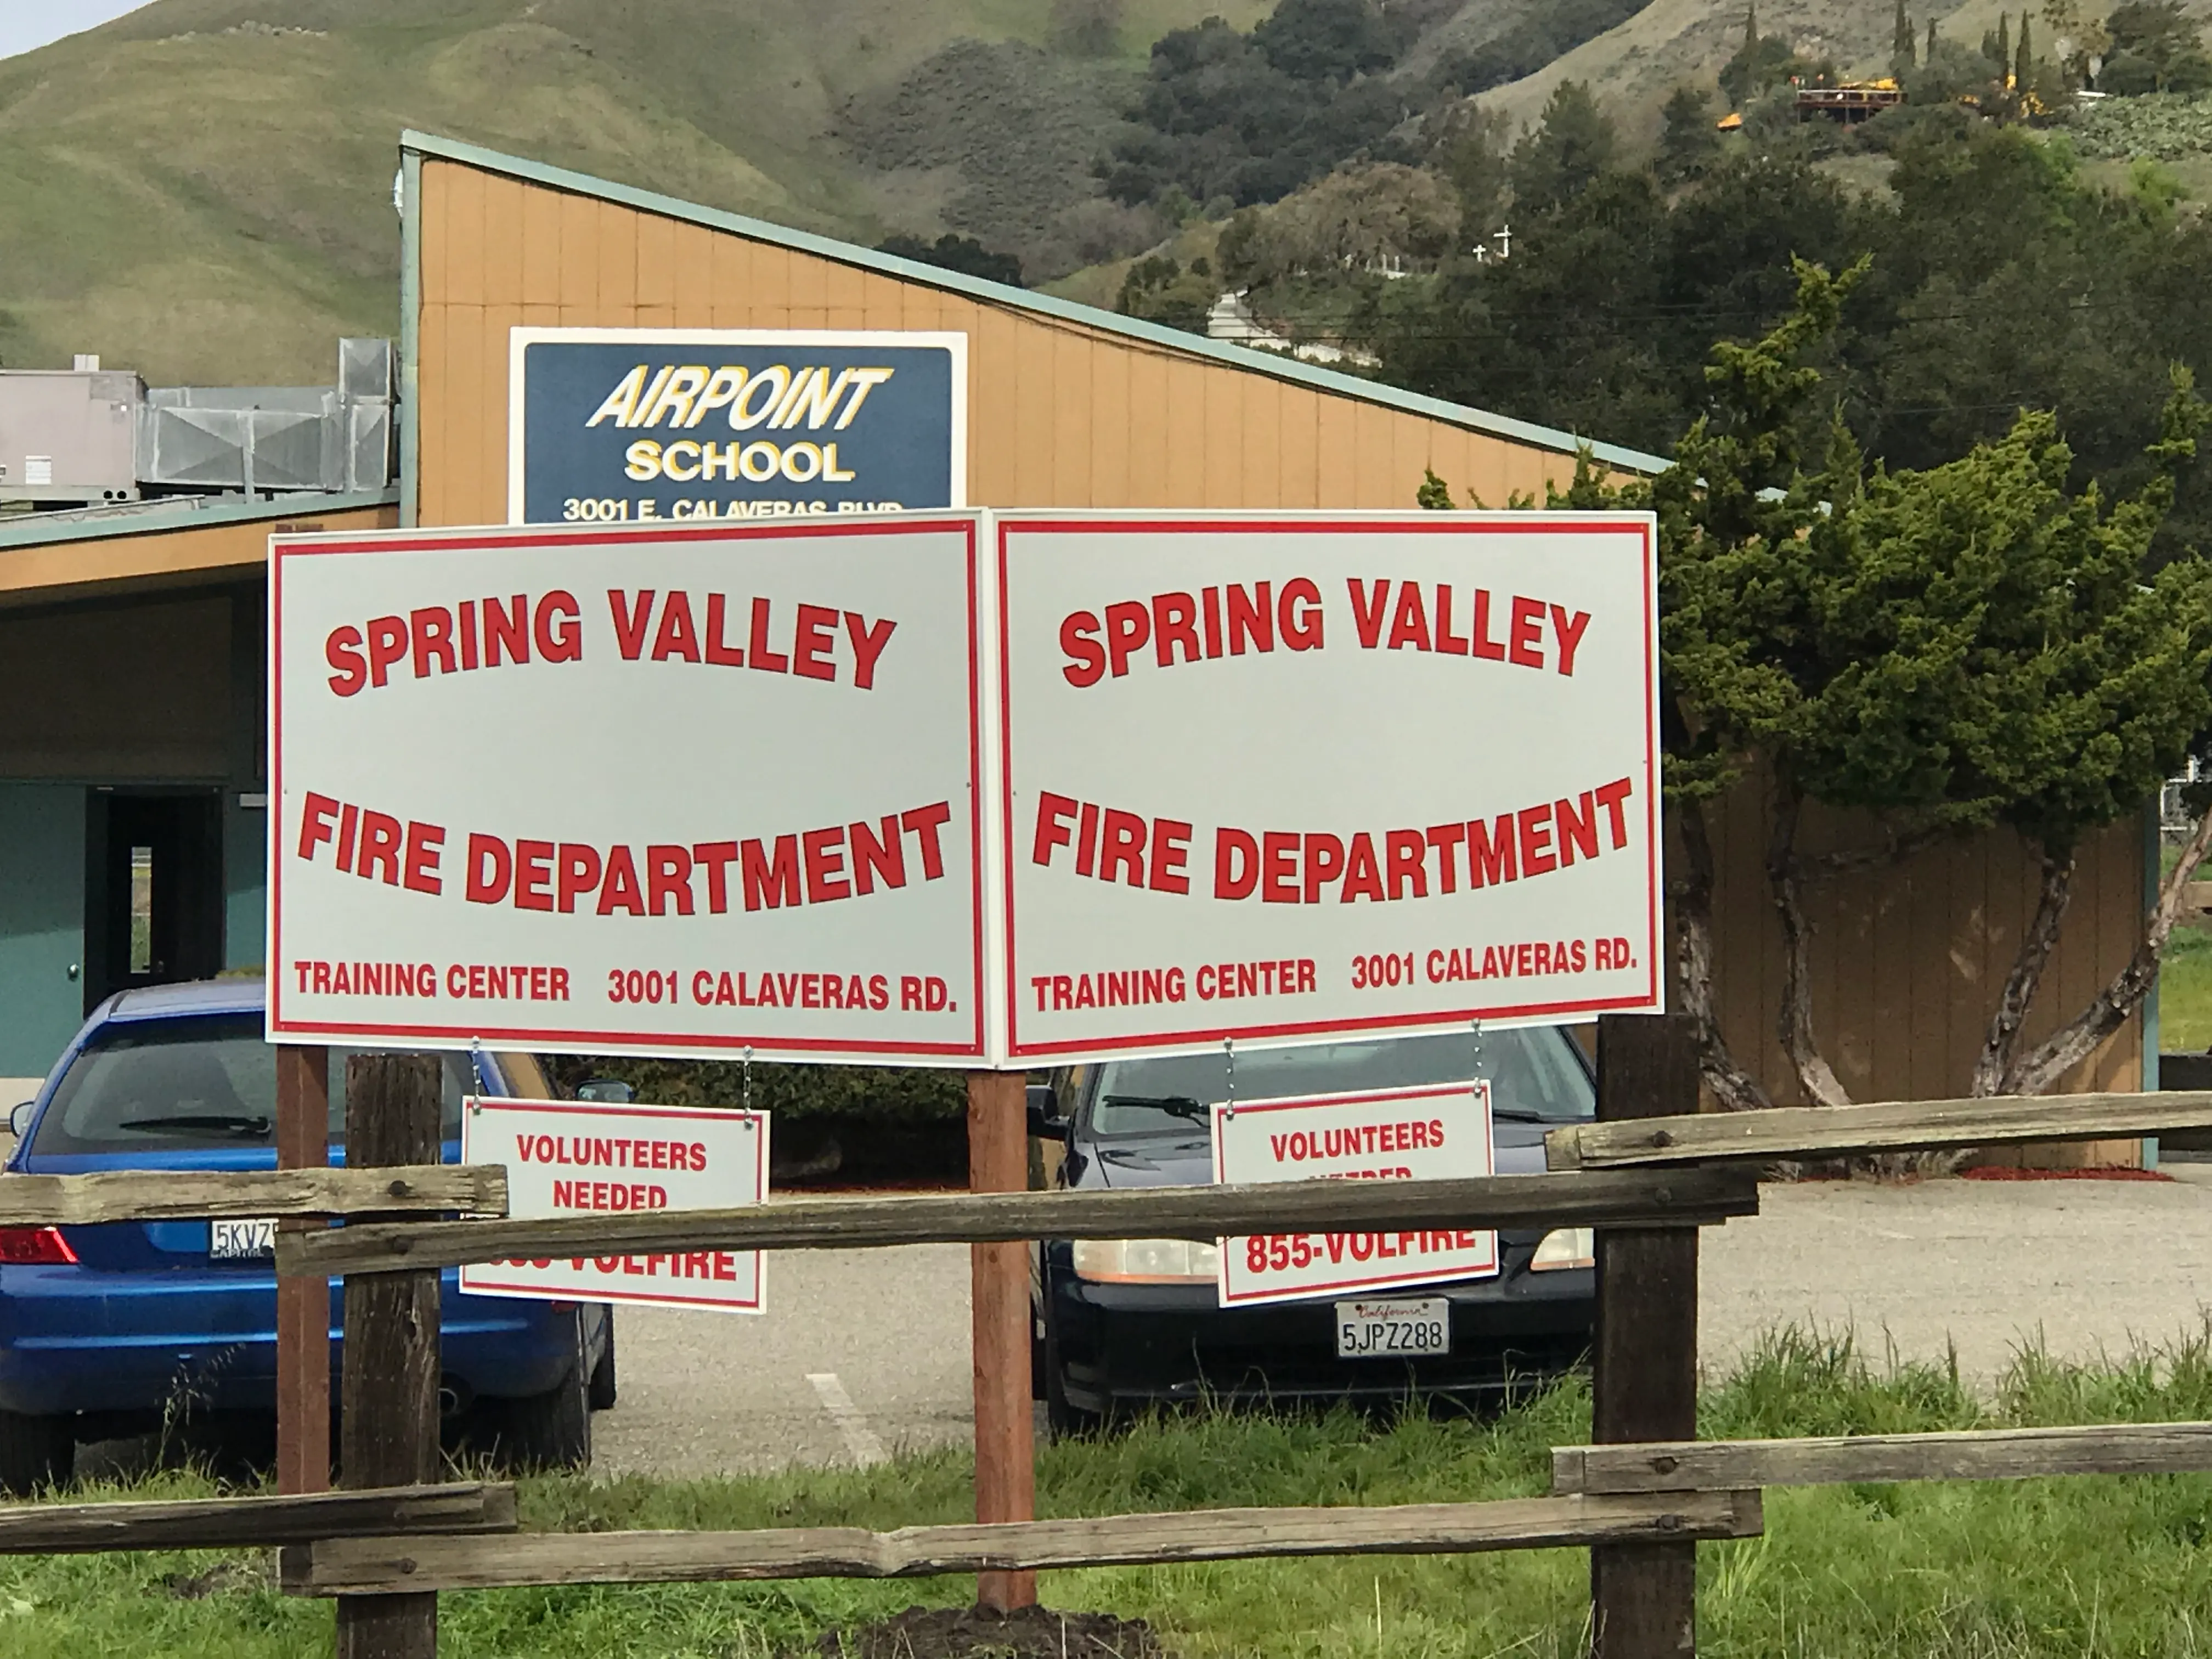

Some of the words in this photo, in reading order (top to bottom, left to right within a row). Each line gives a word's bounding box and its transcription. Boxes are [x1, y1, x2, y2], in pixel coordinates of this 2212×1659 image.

[585, 365, 894, 431] AIRPOINT
[624, 439, 856, 482] SCHOOL
[563, 498, 628, 521] 3001
[638, 499, 662, 521] E.
[325, 590, 582, 697] SPRING
[607, 589, 896, 691] VALLEY
[1059, 577, 1324, 687] SPRING
[1346, 578, 1591, 676] VALLEY
[298, 792, 445, 895] FIRE
[465, 801, 951, 916] DEPARTMENT
[1032, 791, 1193, 895] FIRE
[1214, 777, 1632, 904] DEPARTMENT
[294, 961, 437, 998] TRAINING
[447, 963, 569, 1001] CENTER
[607, 969, 678, 1004] 3001
[692, 970, 889, 1011] CALAVERAS
[900, 976, 956, 1012] RD.
[1031, 967, 1186, 1012] TRAINING
[1195, 958, 1316, 1001] CENTER
[1351, 952, 1414, 989] 3001
[1426, 939, 1587, 984] CALAVERAS
[1594, 936, 1638, 970] RD.
[516, 1134, 707, 1171] VOLUNTEERS
[1270, 1119, 1444, 1162] VOLUNTEERS
[553, 1180, 668, 1211] NEEDED
[217, 1222, 277, 1249] 5KVZ
[1344, 1321, 1442, 1351] 5JPZ288
